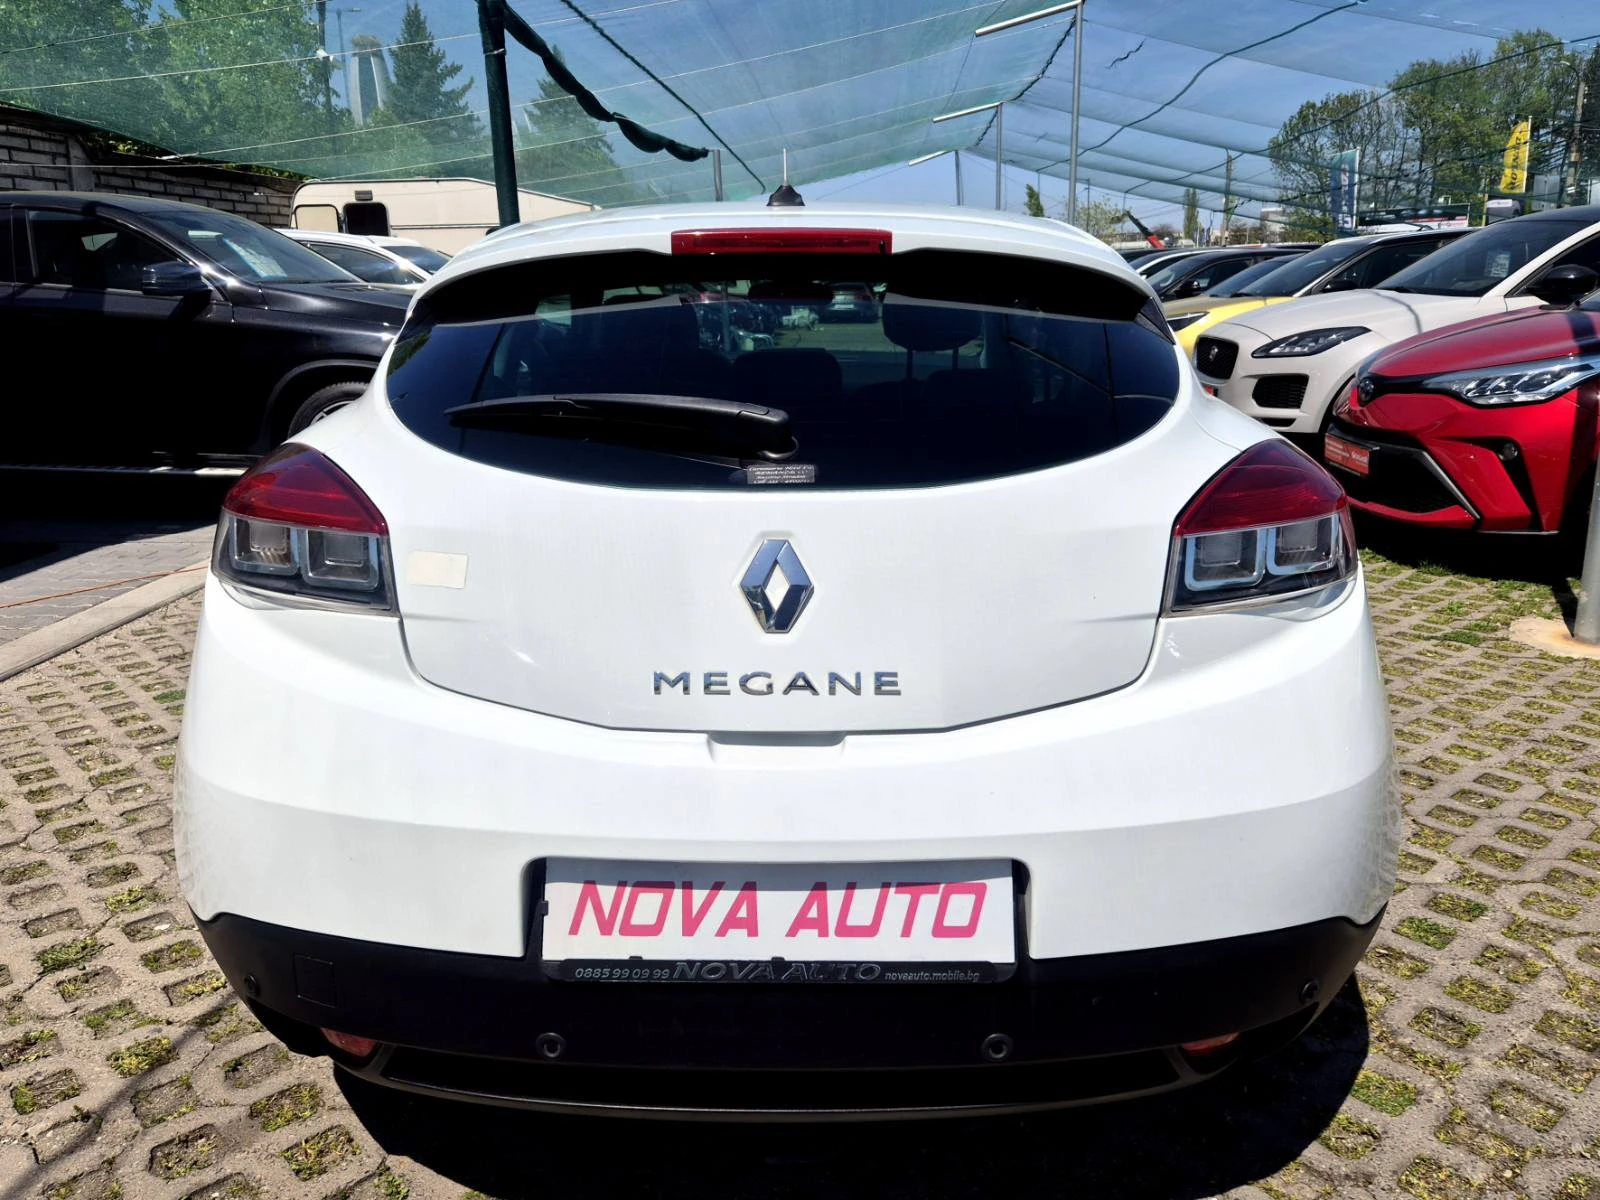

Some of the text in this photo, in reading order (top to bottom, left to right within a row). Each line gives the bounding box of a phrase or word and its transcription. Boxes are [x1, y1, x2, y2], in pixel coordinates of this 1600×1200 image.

[653, 671, 902, 696] MEGANE
[568, 879, 988, 939] NOVA AUTO
[574, 961, 981, 983] 0885 99 09 99 NOVA AUTO novaauto.mobile.bg
